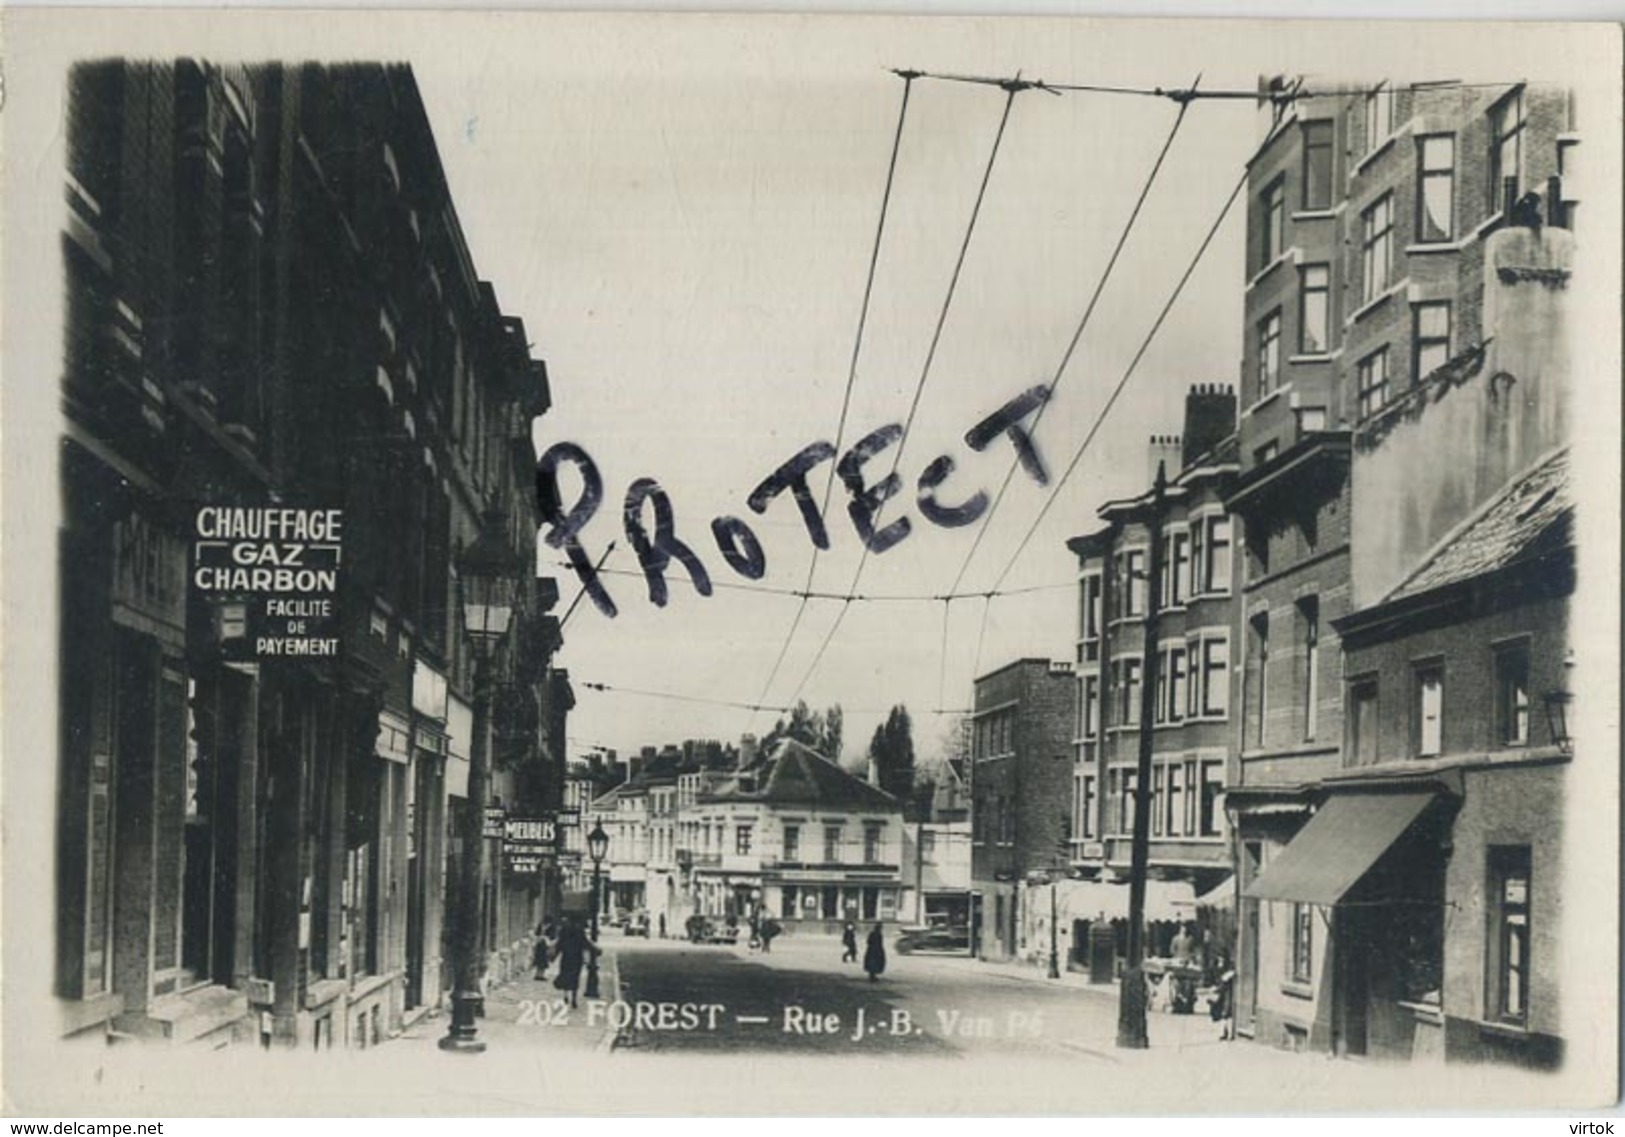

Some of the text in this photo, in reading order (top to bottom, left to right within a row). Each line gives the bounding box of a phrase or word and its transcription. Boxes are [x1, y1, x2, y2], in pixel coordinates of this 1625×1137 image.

[535, 384, 1053, 618] PROTECT
[196, 506, 342, 541] CHAUFFAGE
[232, 542, 305, 566] GAZ
[195, 567, 336, 592] CHARBON
[287, 620, 306, 635] DE
[256, 637, 338, 655] PAYEMENT
